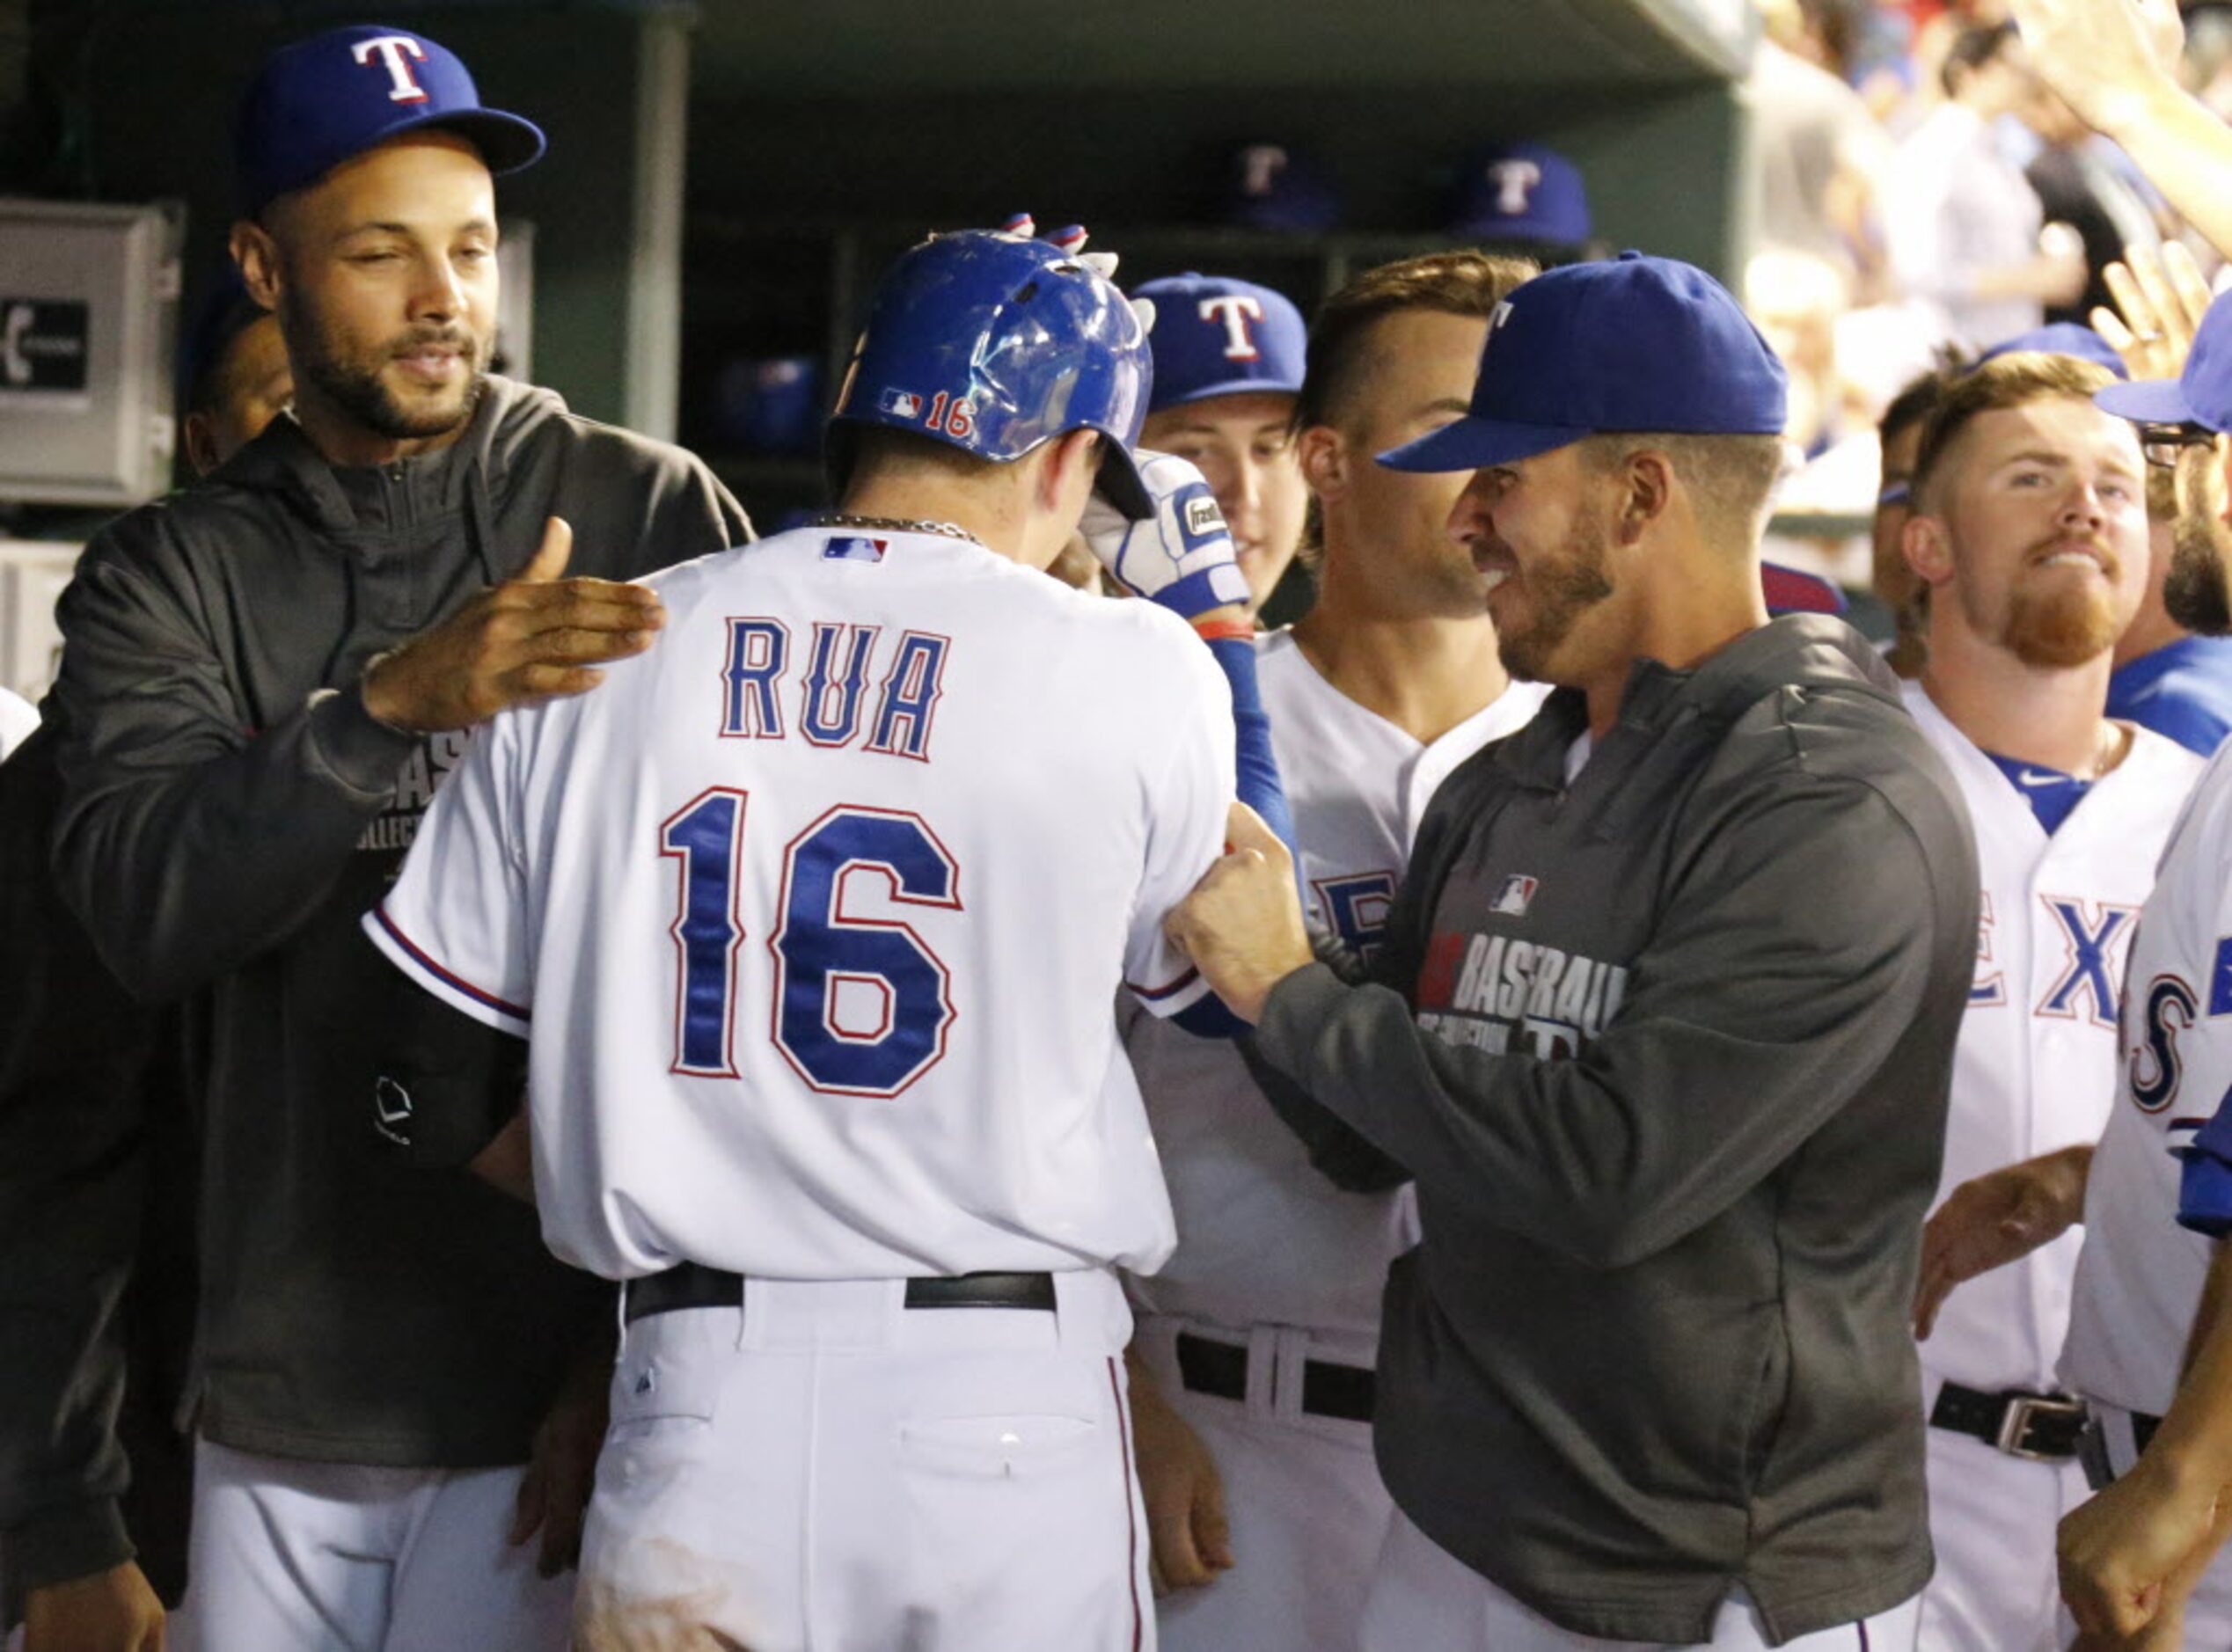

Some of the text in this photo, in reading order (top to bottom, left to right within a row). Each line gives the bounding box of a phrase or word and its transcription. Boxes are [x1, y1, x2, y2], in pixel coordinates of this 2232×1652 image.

[351, 36, 429, 105] T
[1488, 160, 1541, 214] T
[1198, 296, 1265, 362] T
[925, 390, 978, 438] 16
[719, 616, 952, 764] RUA
[659, 785, 964, 1099] 16
